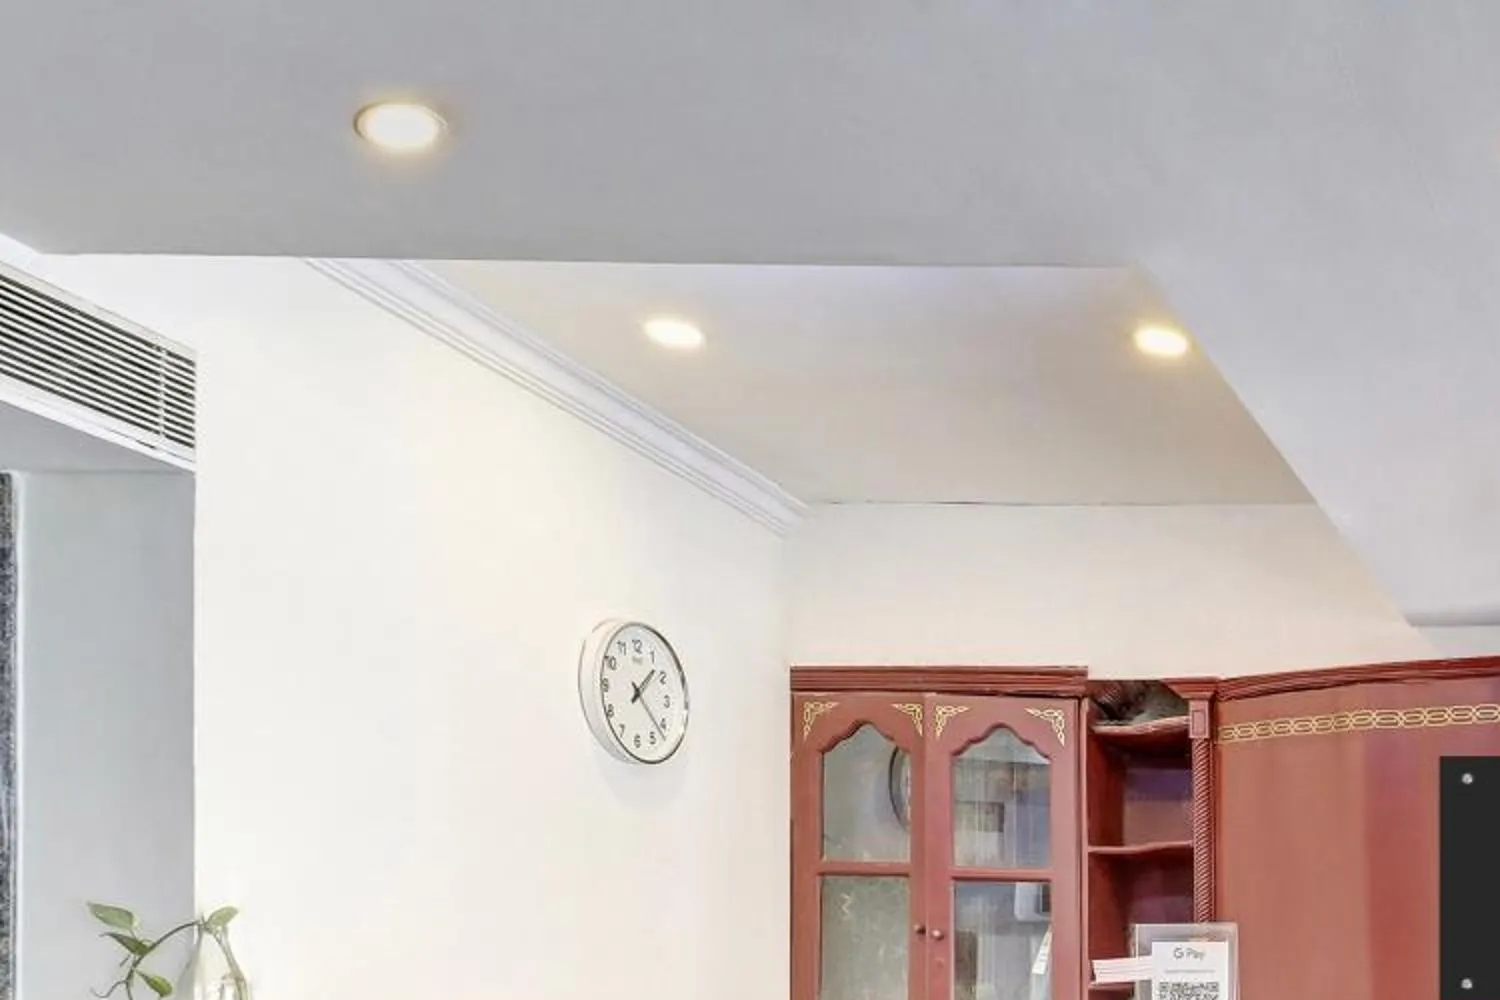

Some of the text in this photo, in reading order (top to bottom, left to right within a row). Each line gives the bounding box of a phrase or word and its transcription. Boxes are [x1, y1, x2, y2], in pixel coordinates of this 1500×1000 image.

[617, 640, 627, 656] 11
[631, 639, 643, 654] 12
[604, 655, 617, 670] 10
[650, 650, 656, 665] 1
[659, 670, 668, 685] 2
[664, 694, 671, 708] 3
[607, 703, 615, 717] 8
[619, 723, 626, 738] 7
[649, 731, 657, 745] 5
[633, 733, 641, 748] 6
